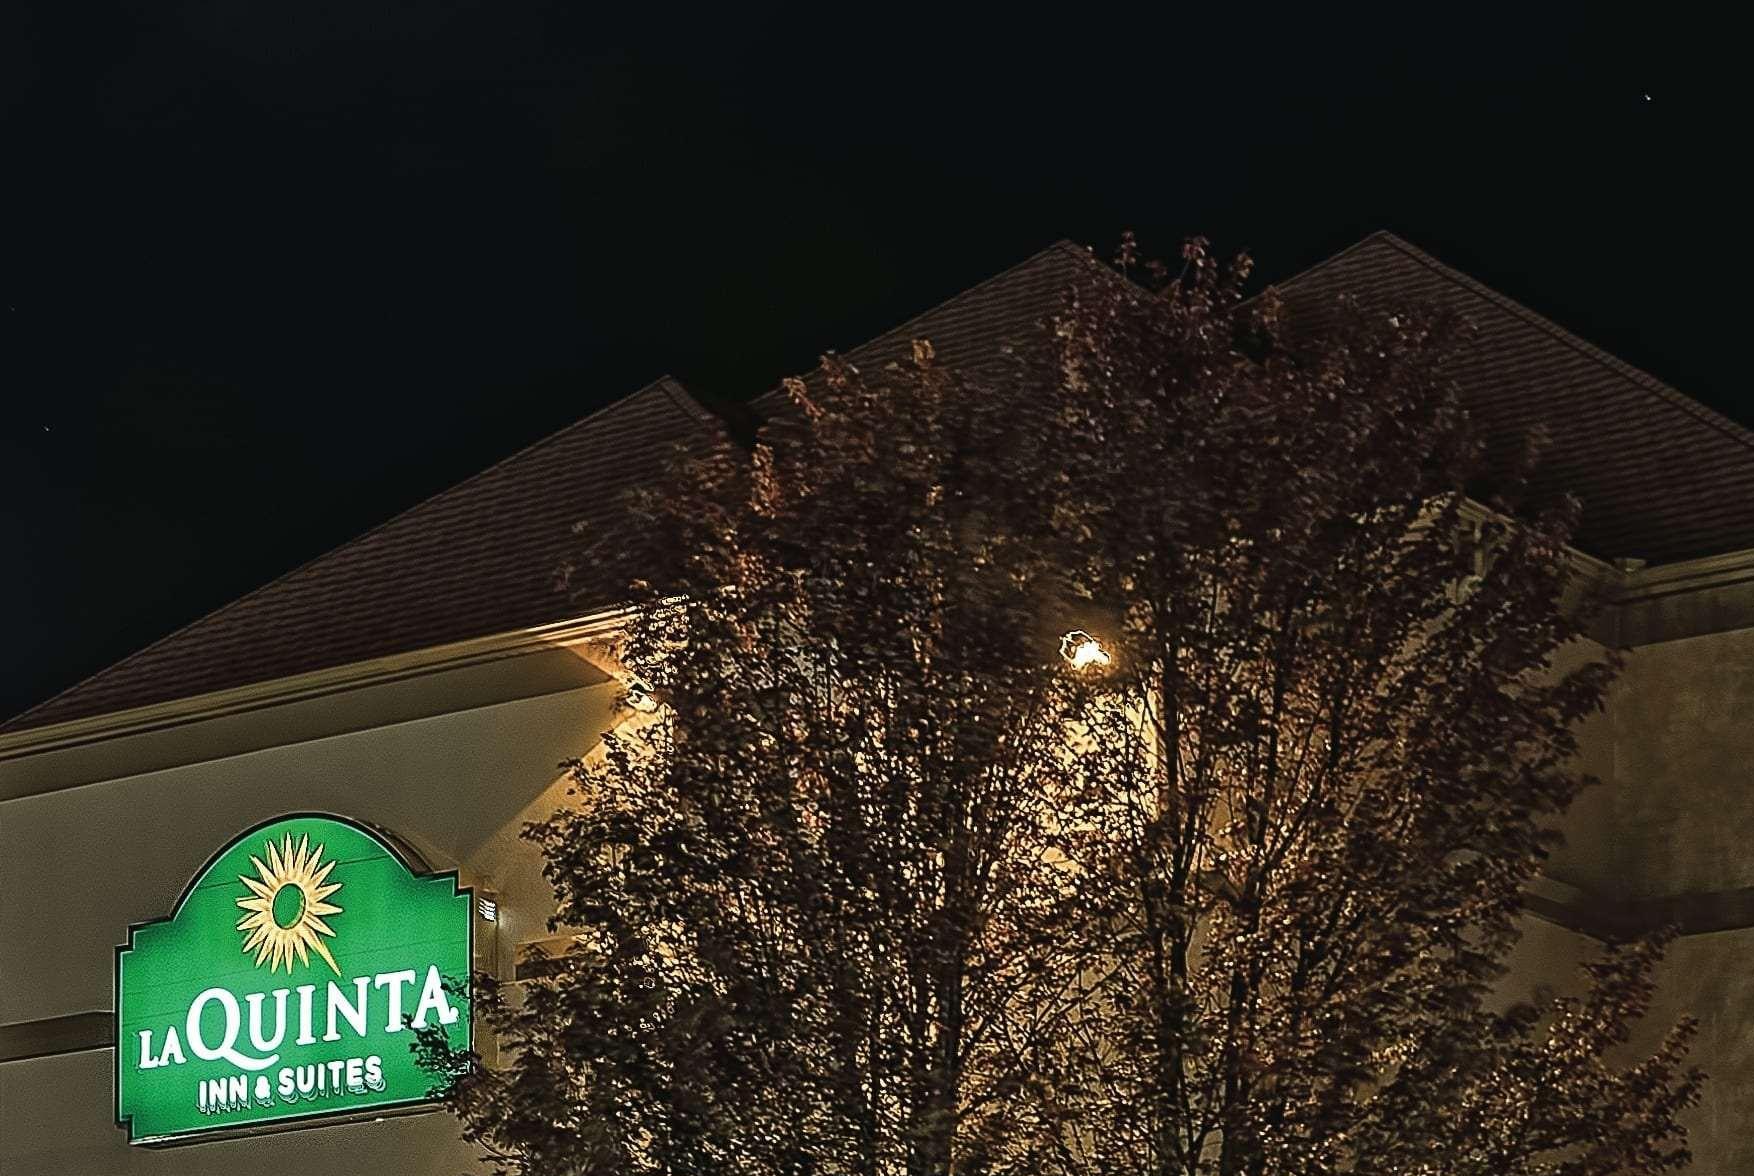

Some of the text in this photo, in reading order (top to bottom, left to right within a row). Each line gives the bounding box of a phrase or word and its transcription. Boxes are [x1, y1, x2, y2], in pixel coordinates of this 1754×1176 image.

[138, 965, 459, 1071] LA QUINTA
[198, 1055, 384, 1111] INN & SUITES
